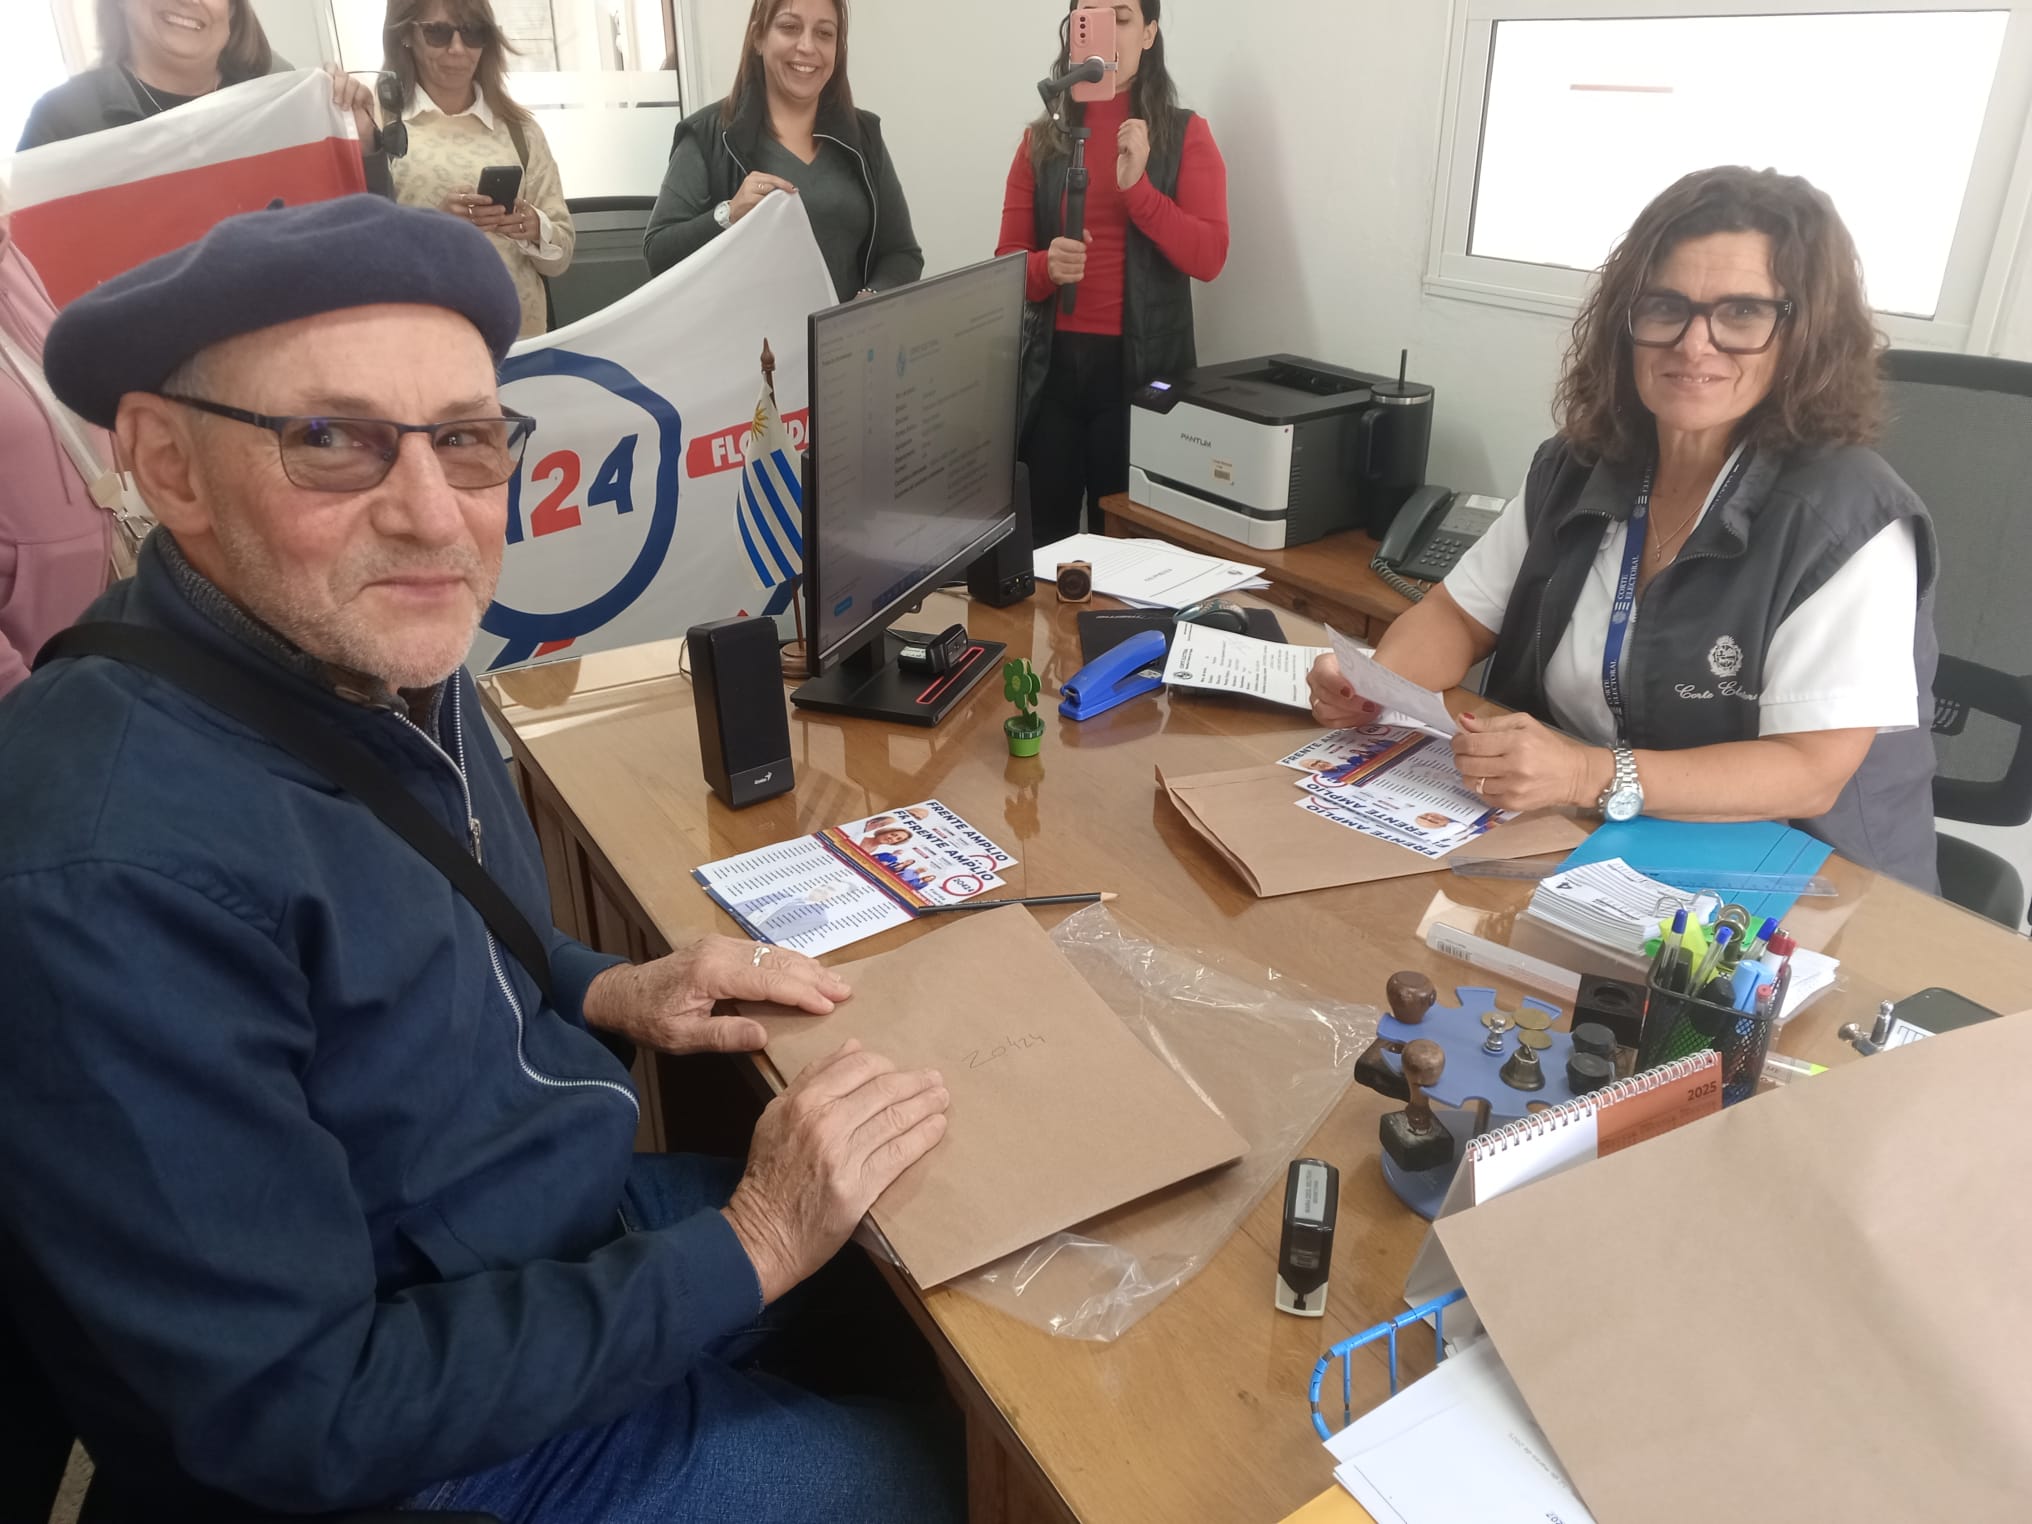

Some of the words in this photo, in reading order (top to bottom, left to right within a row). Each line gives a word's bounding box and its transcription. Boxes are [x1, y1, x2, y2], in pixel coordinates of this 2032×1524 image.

[1180, 433, 1212, 449] PANTUM
[1617, 574, 1629, 600] CORTE
[1624, 554, 1640, 600] ELECTORAL
[1674, 683, 1714, 700] Corte
[1282, 742, 1322, 764] FRENTE
[1306, 783, 1367, 810] AMPLIO
[1306, 804, 1371, 830] AMPLIO
[1367, 808, 1430, 837] FRENTE
[926, 801, 969, 830] FRENTE
[963, 831, 1009, 862] AMPLIO
[1370, 829, 1439, 856] FRENTE
[903, 820, 950, 848] FRENTE
[944, 850, 995, 881] AMPLIO
[1687, 1080, 1718, 1101] 2025
